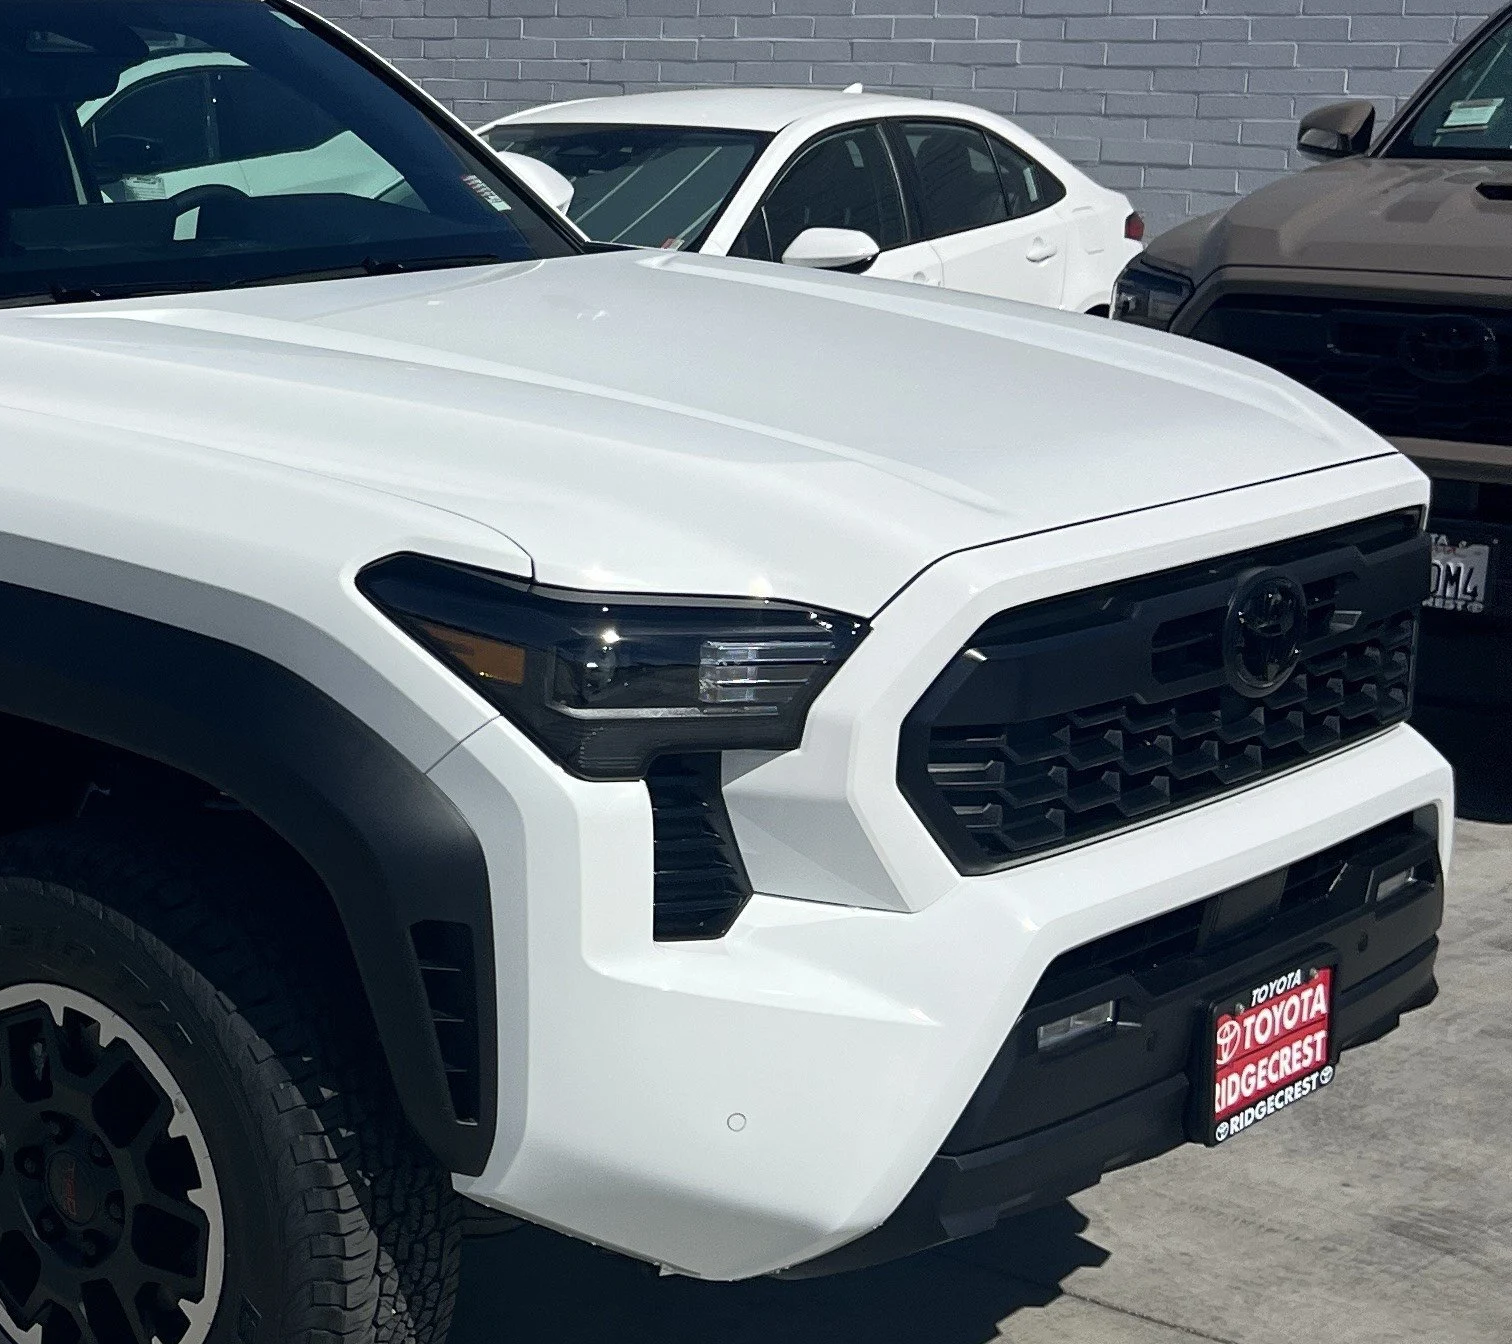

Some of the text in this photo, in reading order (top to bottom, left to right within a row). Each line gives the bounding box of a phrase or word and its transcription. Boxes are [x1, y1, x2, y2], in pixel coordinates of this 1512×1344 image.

[1243, 984, 1328, 1050] TOYOTA
[1251, 968, 1301, 1006] TOYOTA
[1229, 1072, 1319, 1135] RIDGECREST
